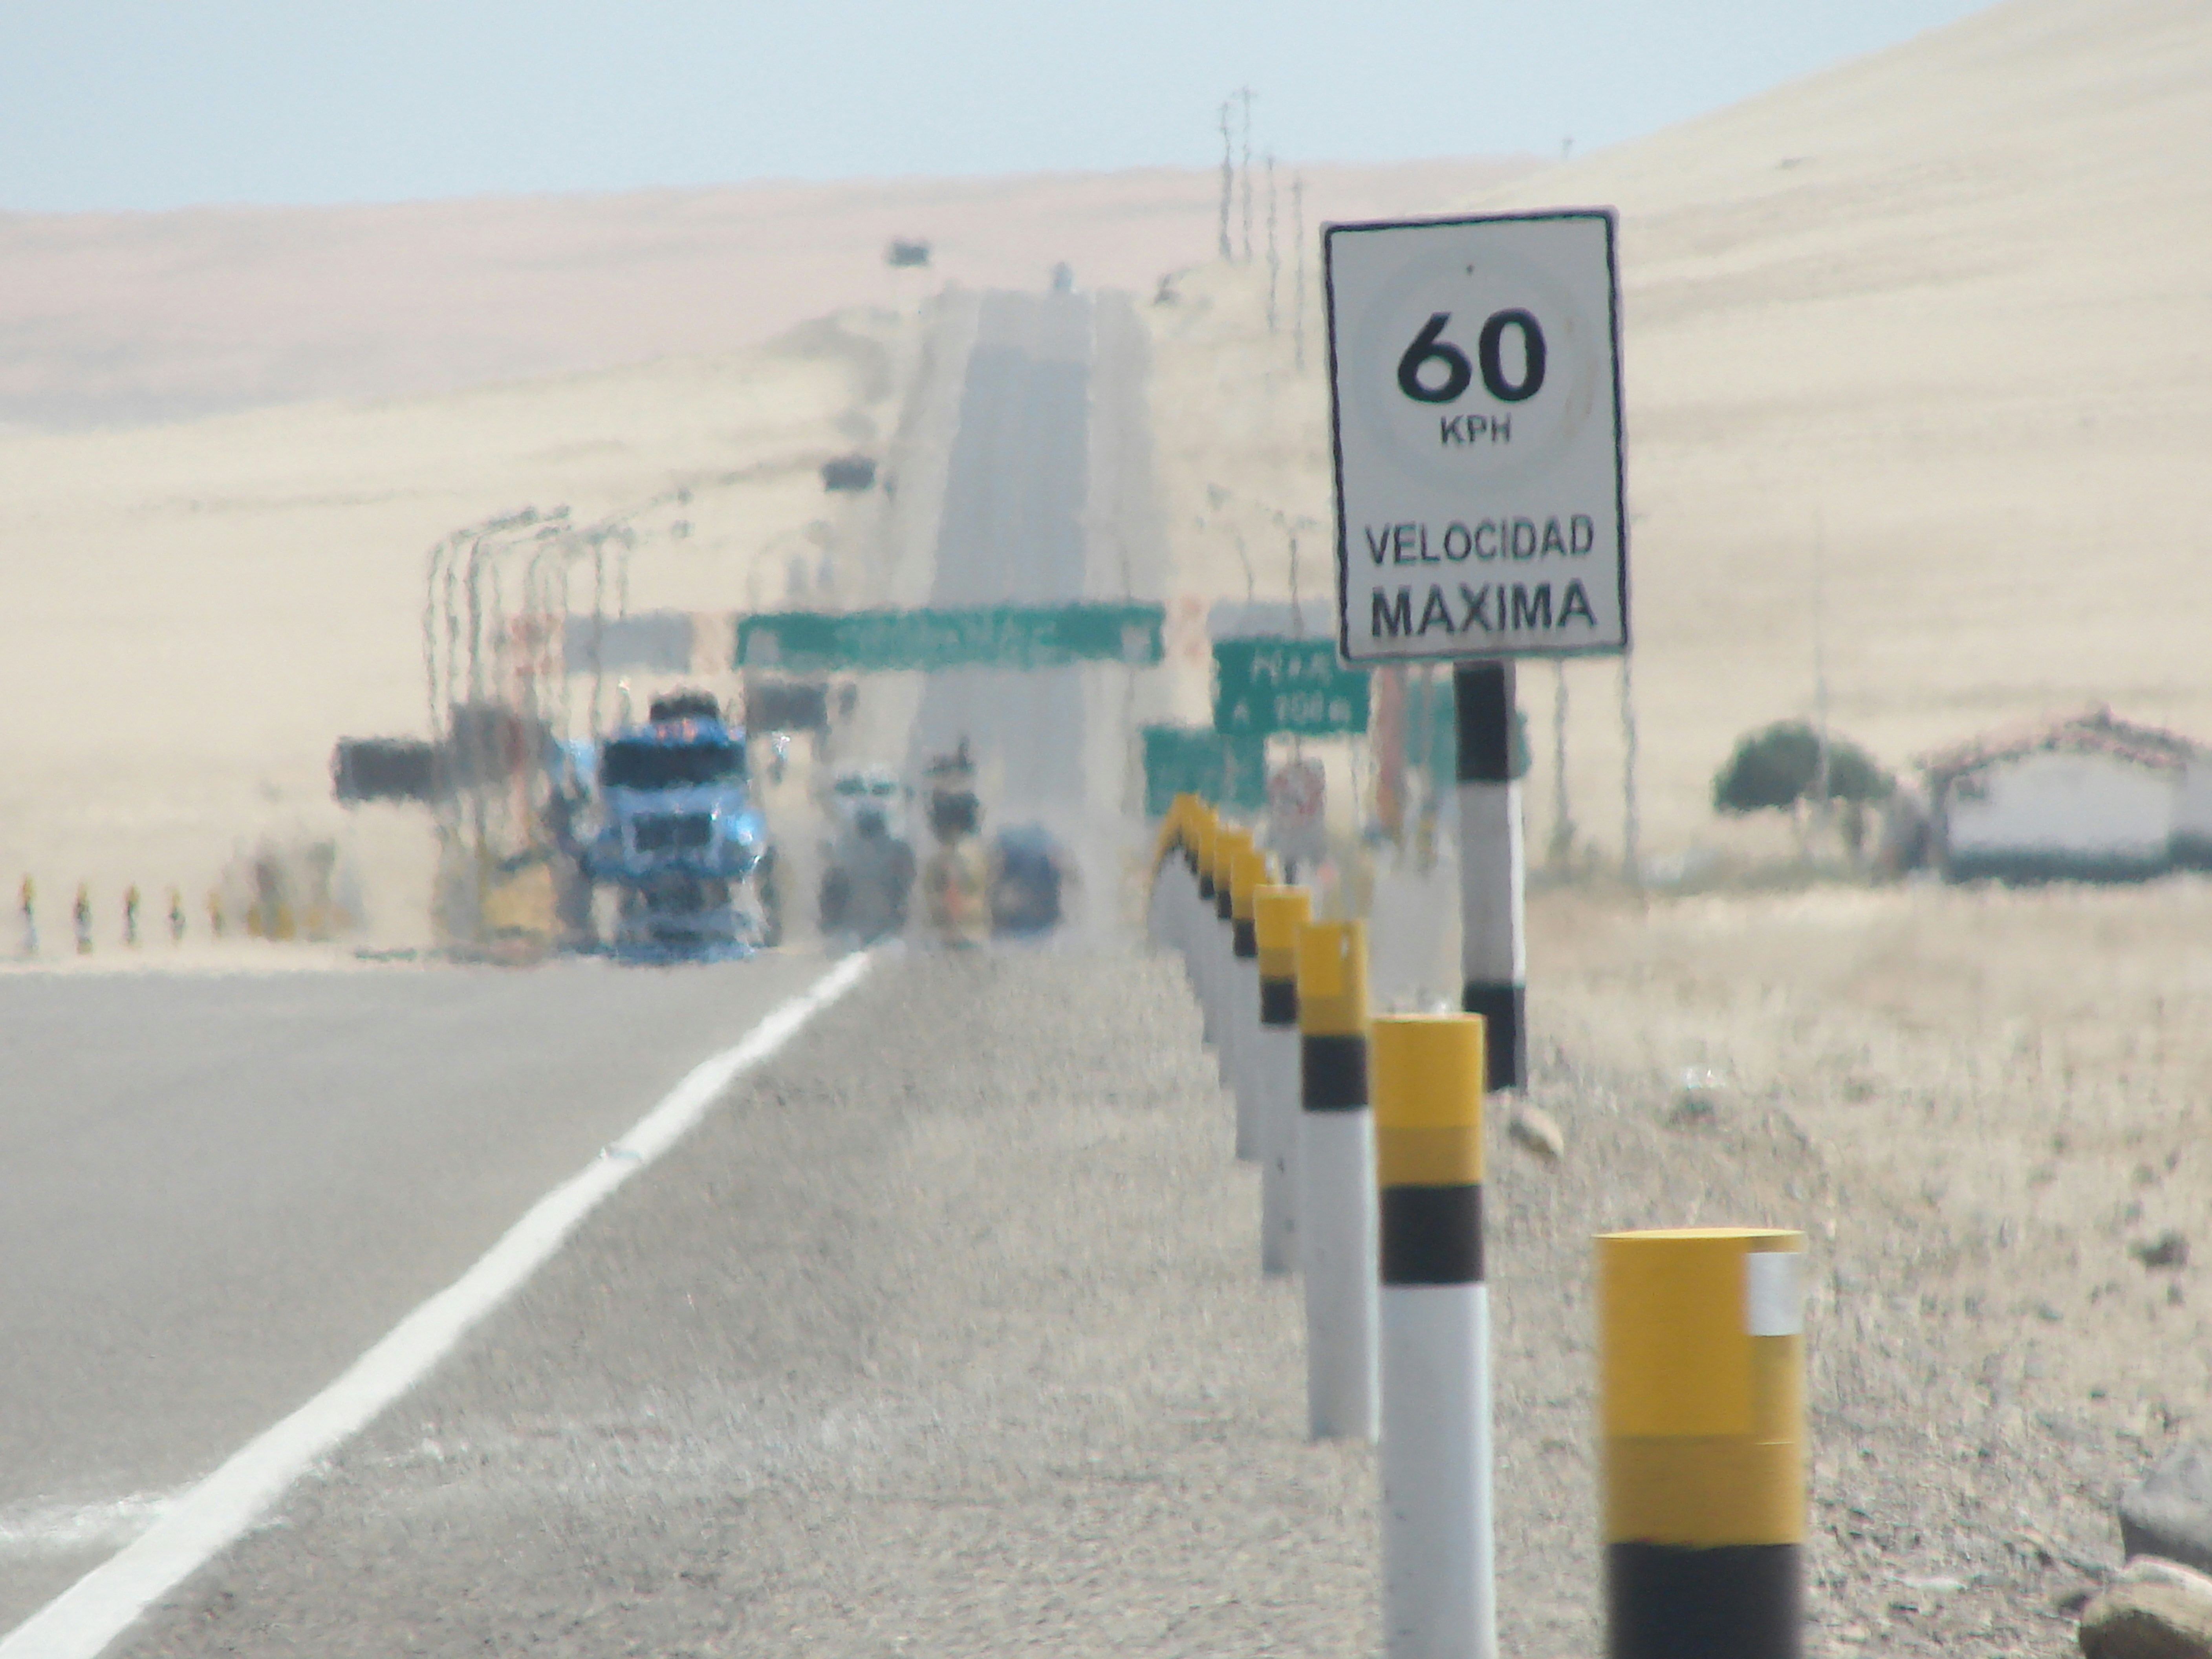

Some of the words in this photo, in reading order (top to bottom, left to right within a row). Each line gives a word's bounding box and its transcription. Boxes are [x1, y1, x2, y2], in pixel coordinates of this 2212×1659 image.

[1397, 307, 1547, 403] 60
[1440, 413, 1512, 445] KPH
[1364, 513, 1595, 566] VELOCIDAD
[1370, 577, 1597, 640] MAXIMA
